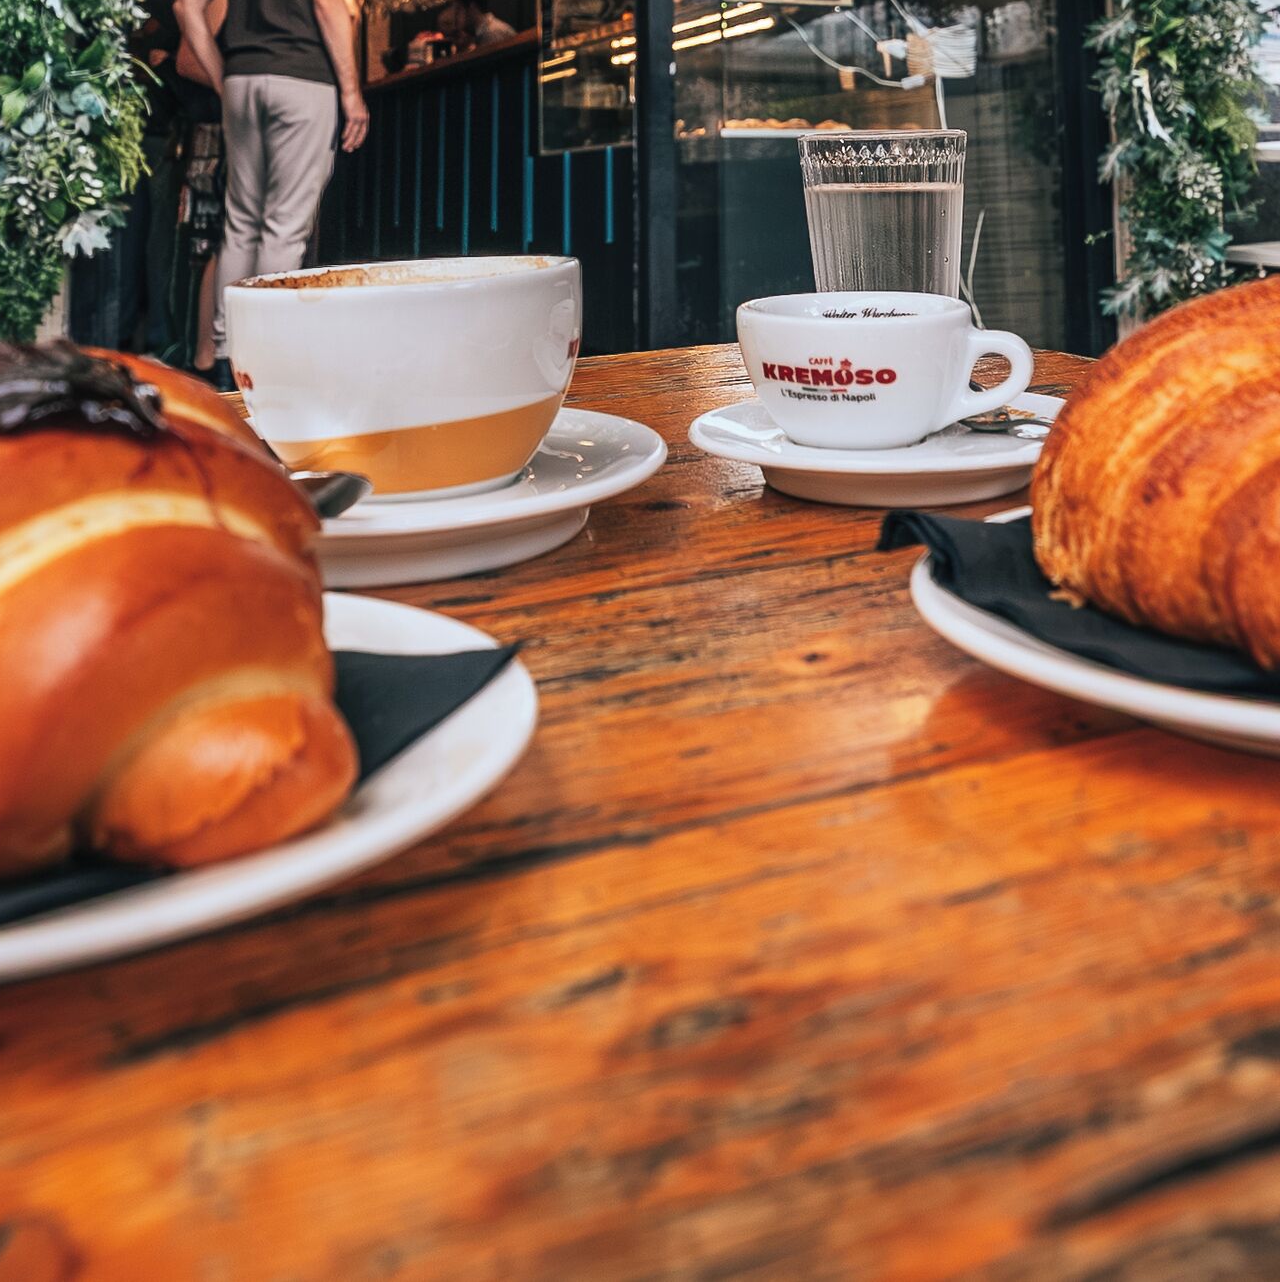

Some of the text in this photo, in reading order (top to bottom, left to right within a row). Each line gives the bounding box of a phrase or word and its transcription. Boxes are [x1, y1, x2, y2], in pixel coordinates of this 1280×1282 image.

[780, 387, 876, 404] L'Espresso di Napoli
